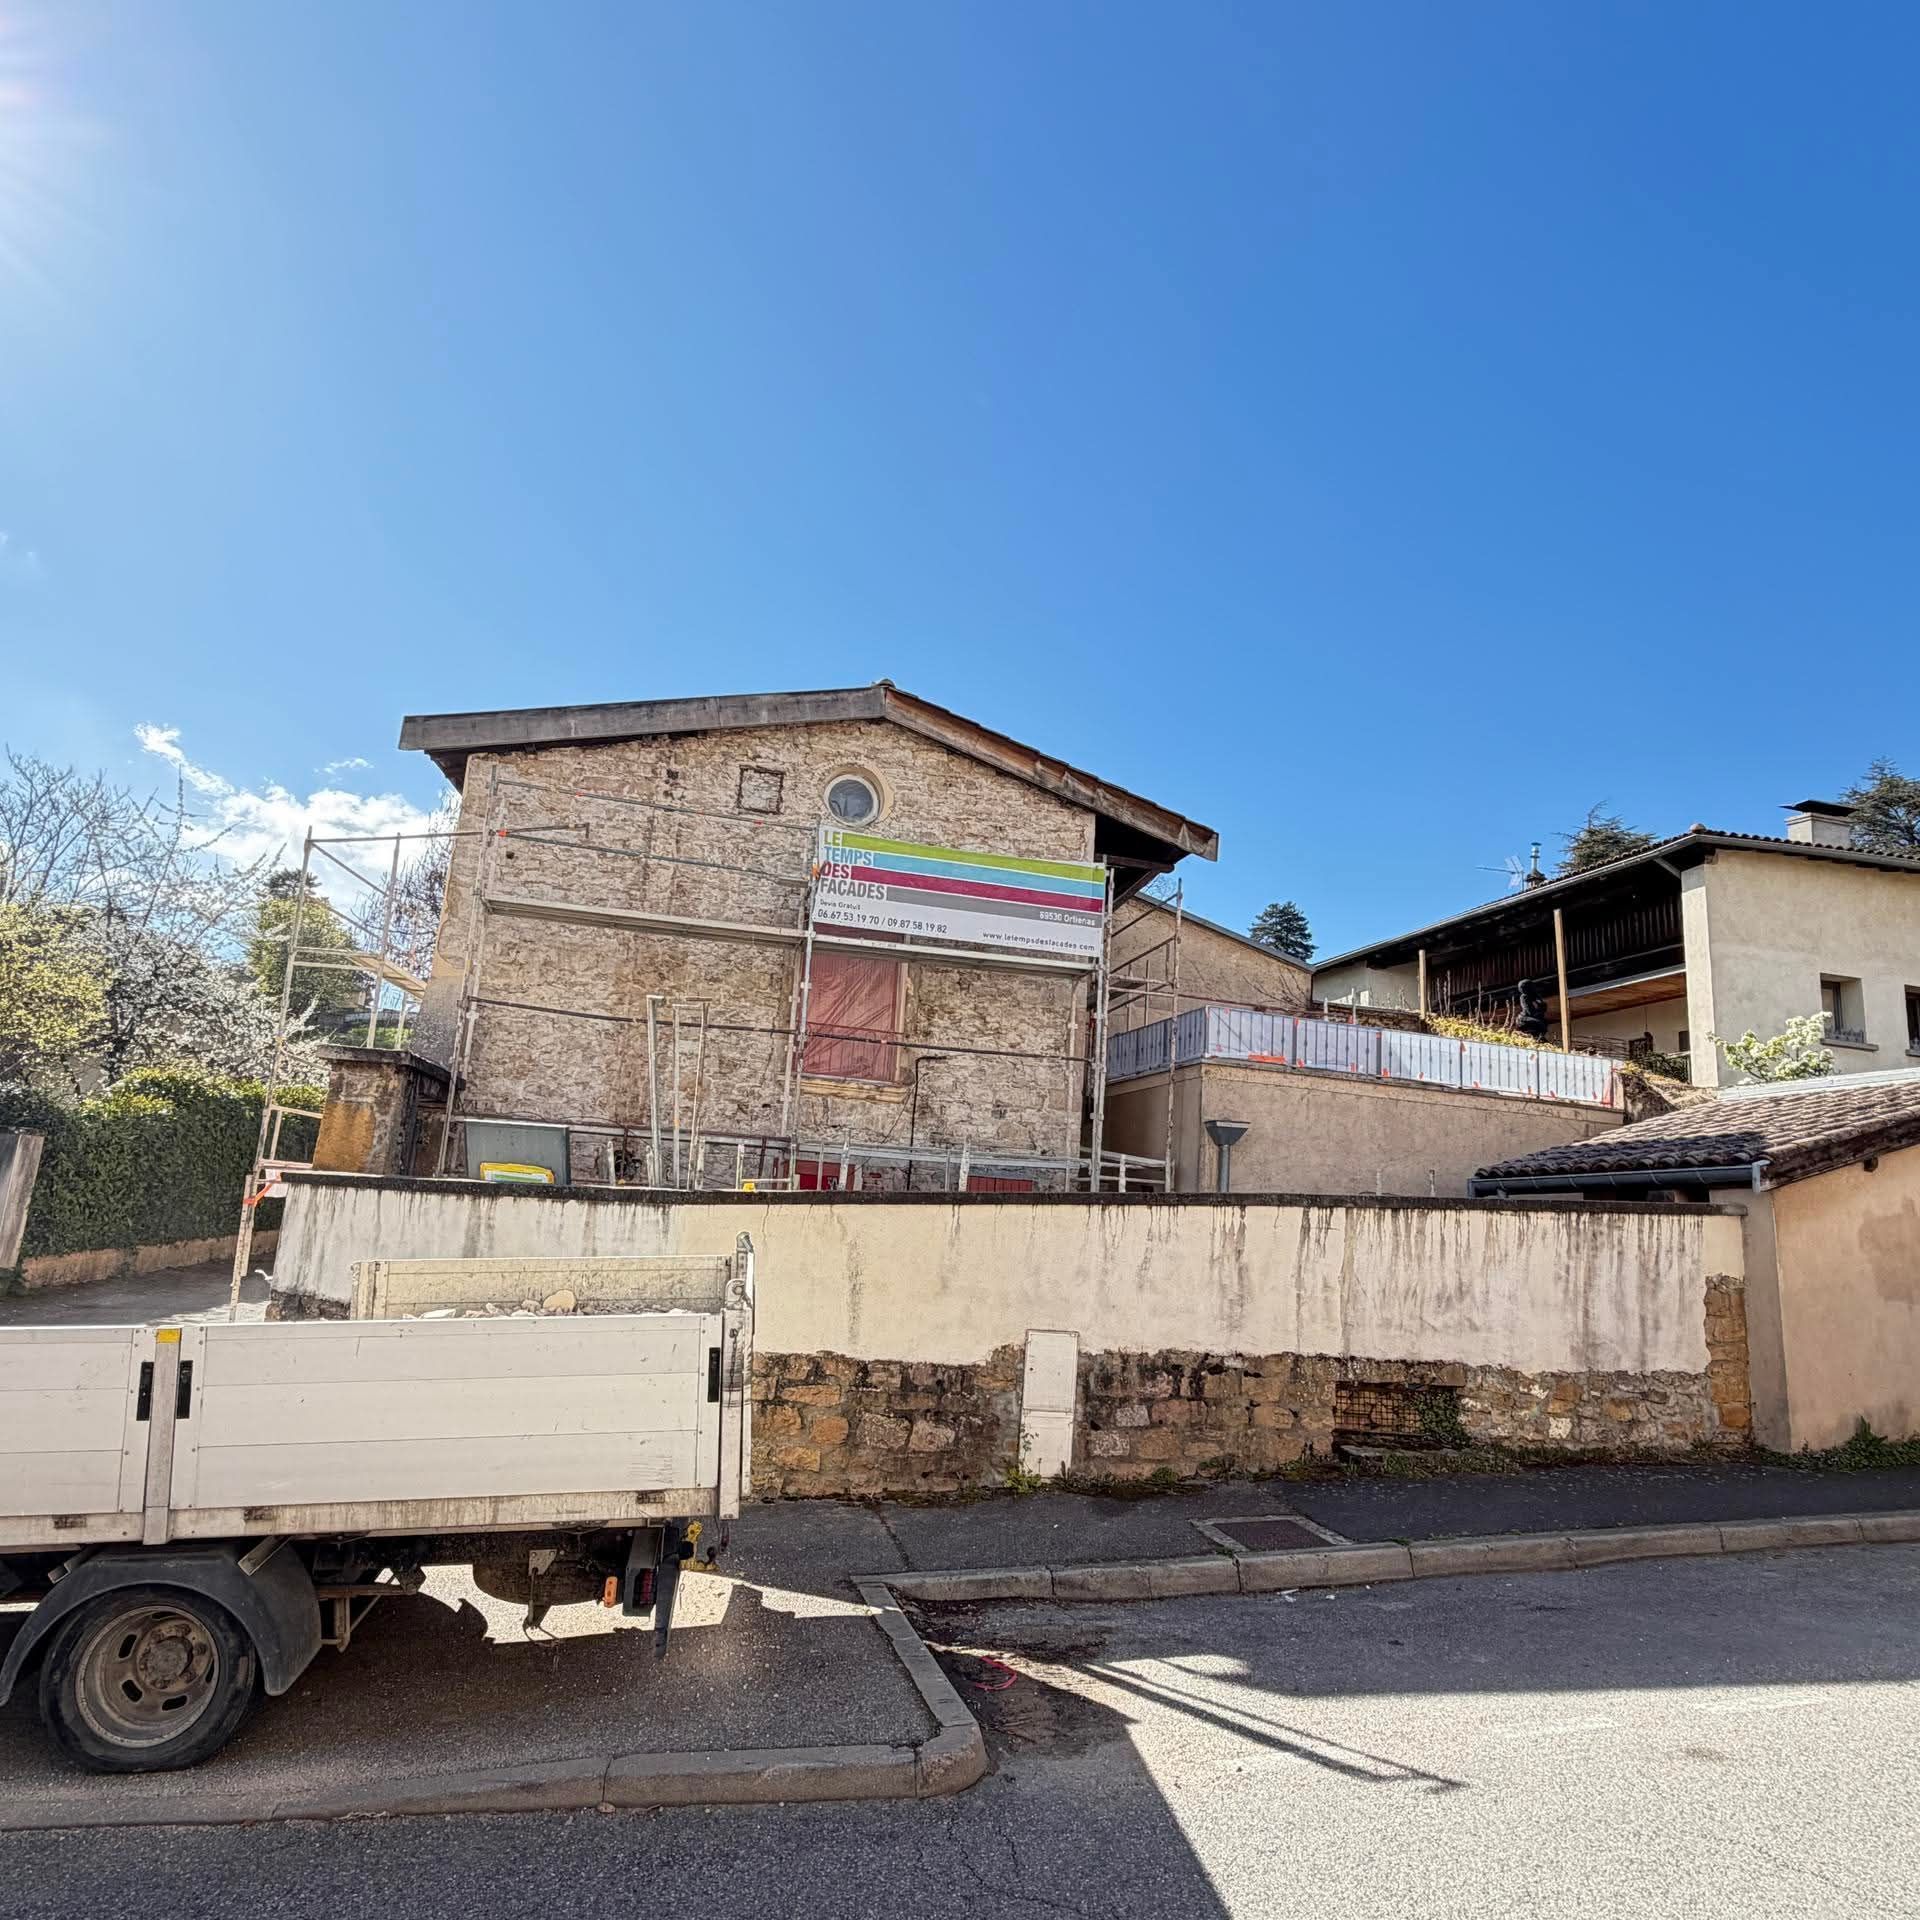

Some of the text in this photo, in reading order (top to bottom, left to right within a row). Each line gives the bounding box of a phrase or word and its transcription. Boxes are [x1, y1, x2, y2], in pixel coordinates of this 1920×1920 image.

[824, 830, 842, 846] LE
[824, 846, 872, 866] TEMPS
[820, 861, 850, 879] DES
[820, 899, 837, 907] Devis
[818, 909, 880, 925] 06.67.53.19.70
[887, 918, 948, 934] 09.87.58.19.82
[1040, 911, 1063, 921] 69530
